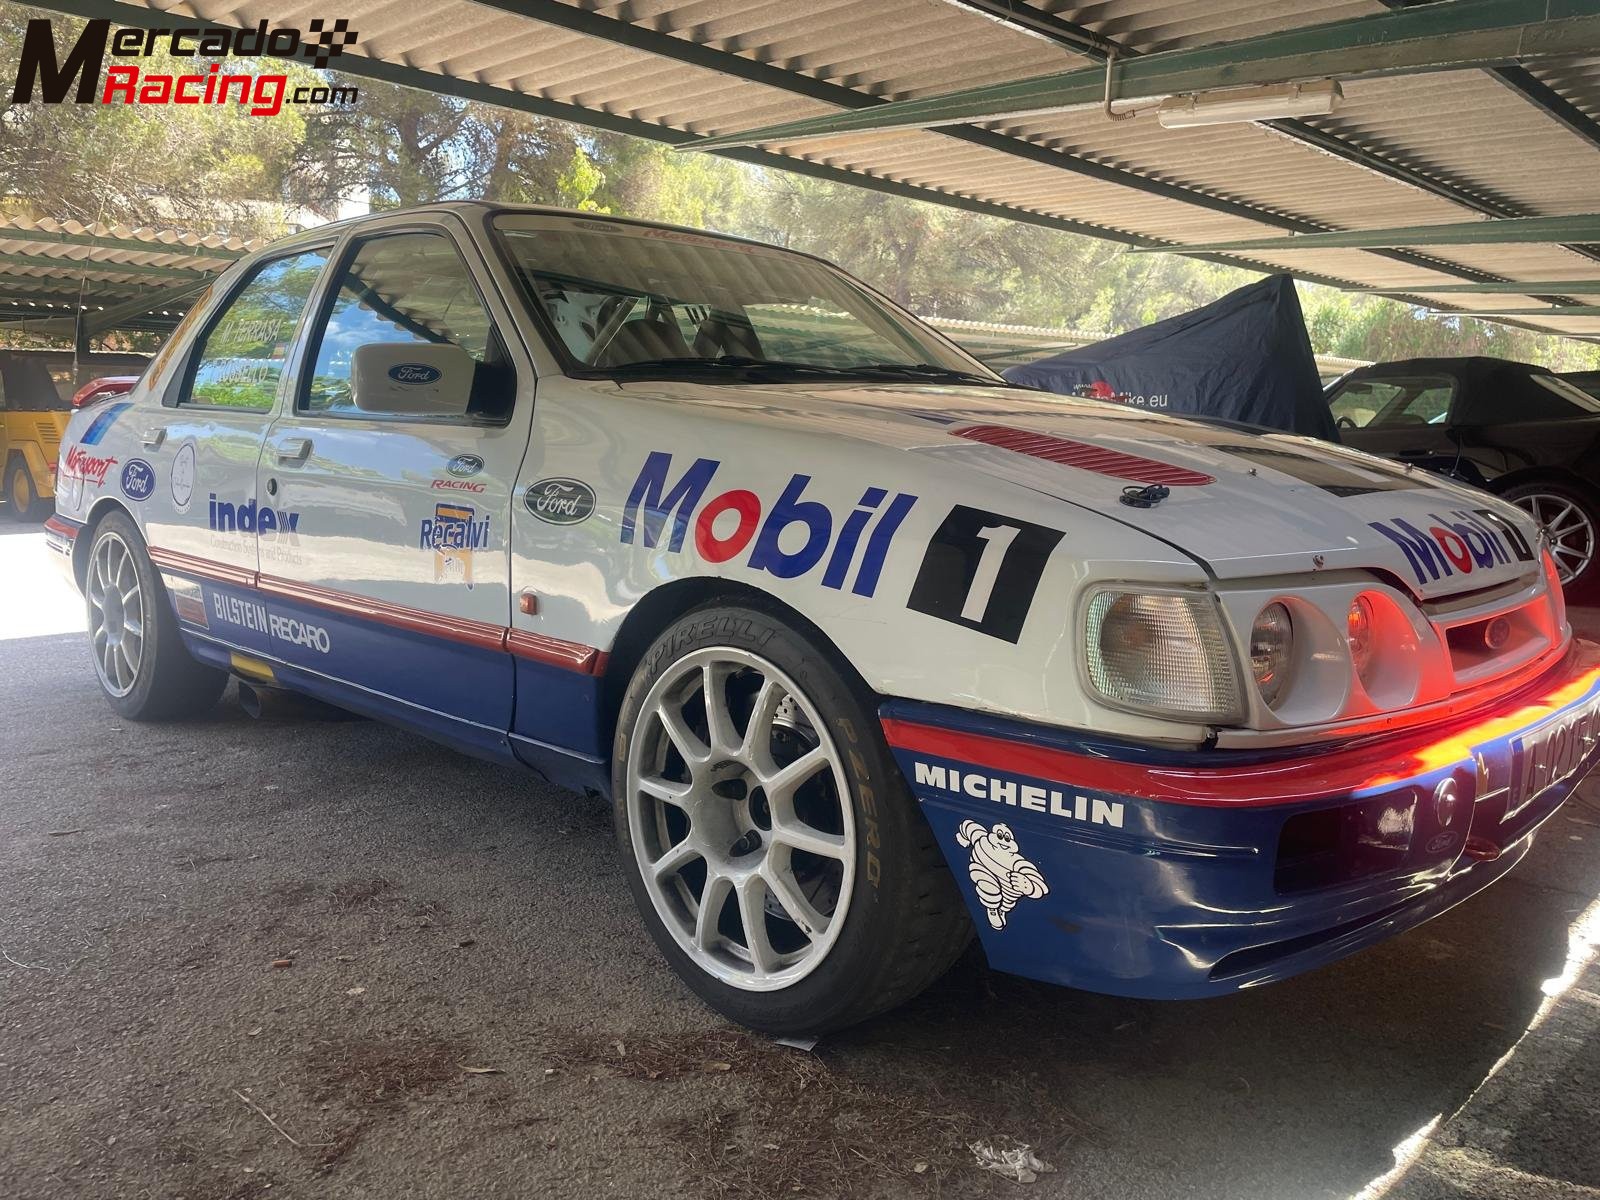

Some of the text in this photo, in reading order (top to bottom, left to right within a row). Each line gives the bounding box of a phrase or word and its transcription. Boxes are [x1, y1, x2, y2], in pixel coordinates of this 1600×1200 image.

[398, 366, 431, 380] Ford
[125, 464, 149, 493] Ford
[431, 479, 487, 493] RACING
[453, 457, 477, 473] Ford
[209, 492, 300, 547] index
[536, 483, 581, 516] Ford
[420, 515, 490, 551] Recalvi
[620, 451, 1022, 624] Mobil 1
[1367, 510, 1512, 585] Mobil
[213, 593, 330, 653] BILSTEIN RECARO
[648, 614, 776, 675] PIRELLI
[914, 762, 1125, 828] MICHELIN
